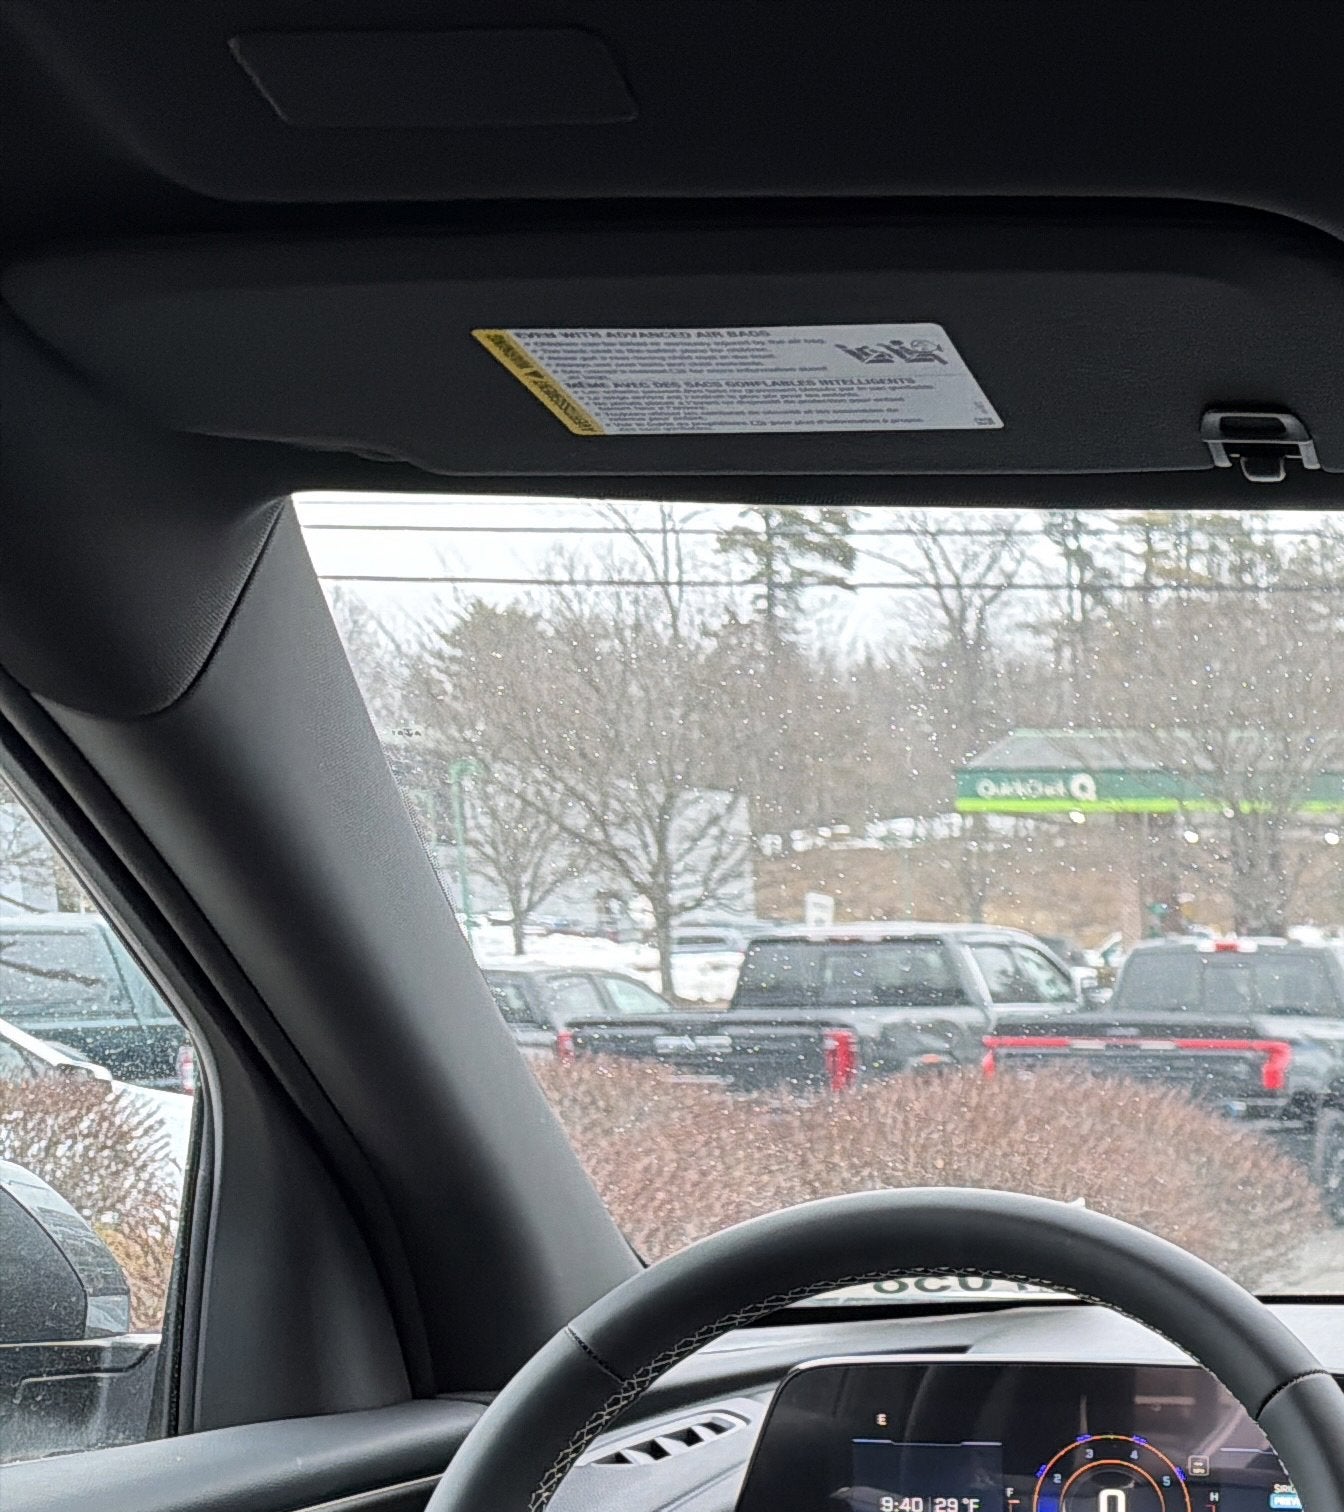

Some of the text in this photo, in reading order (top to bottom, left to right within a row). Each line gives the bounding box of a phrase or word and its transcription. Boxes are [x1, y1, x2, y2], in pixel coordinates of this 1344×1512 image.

[1086, 1450, 1094, 1459] 3
[1130, 1450, 1138, 1459] 4
[1053, 1473, 1062, 1483] 2
[1162, 1476, 1171, 1486] 5
[1006, 1487, 1015, 1498] F
[1210, 1492, 1219, 1501] H
